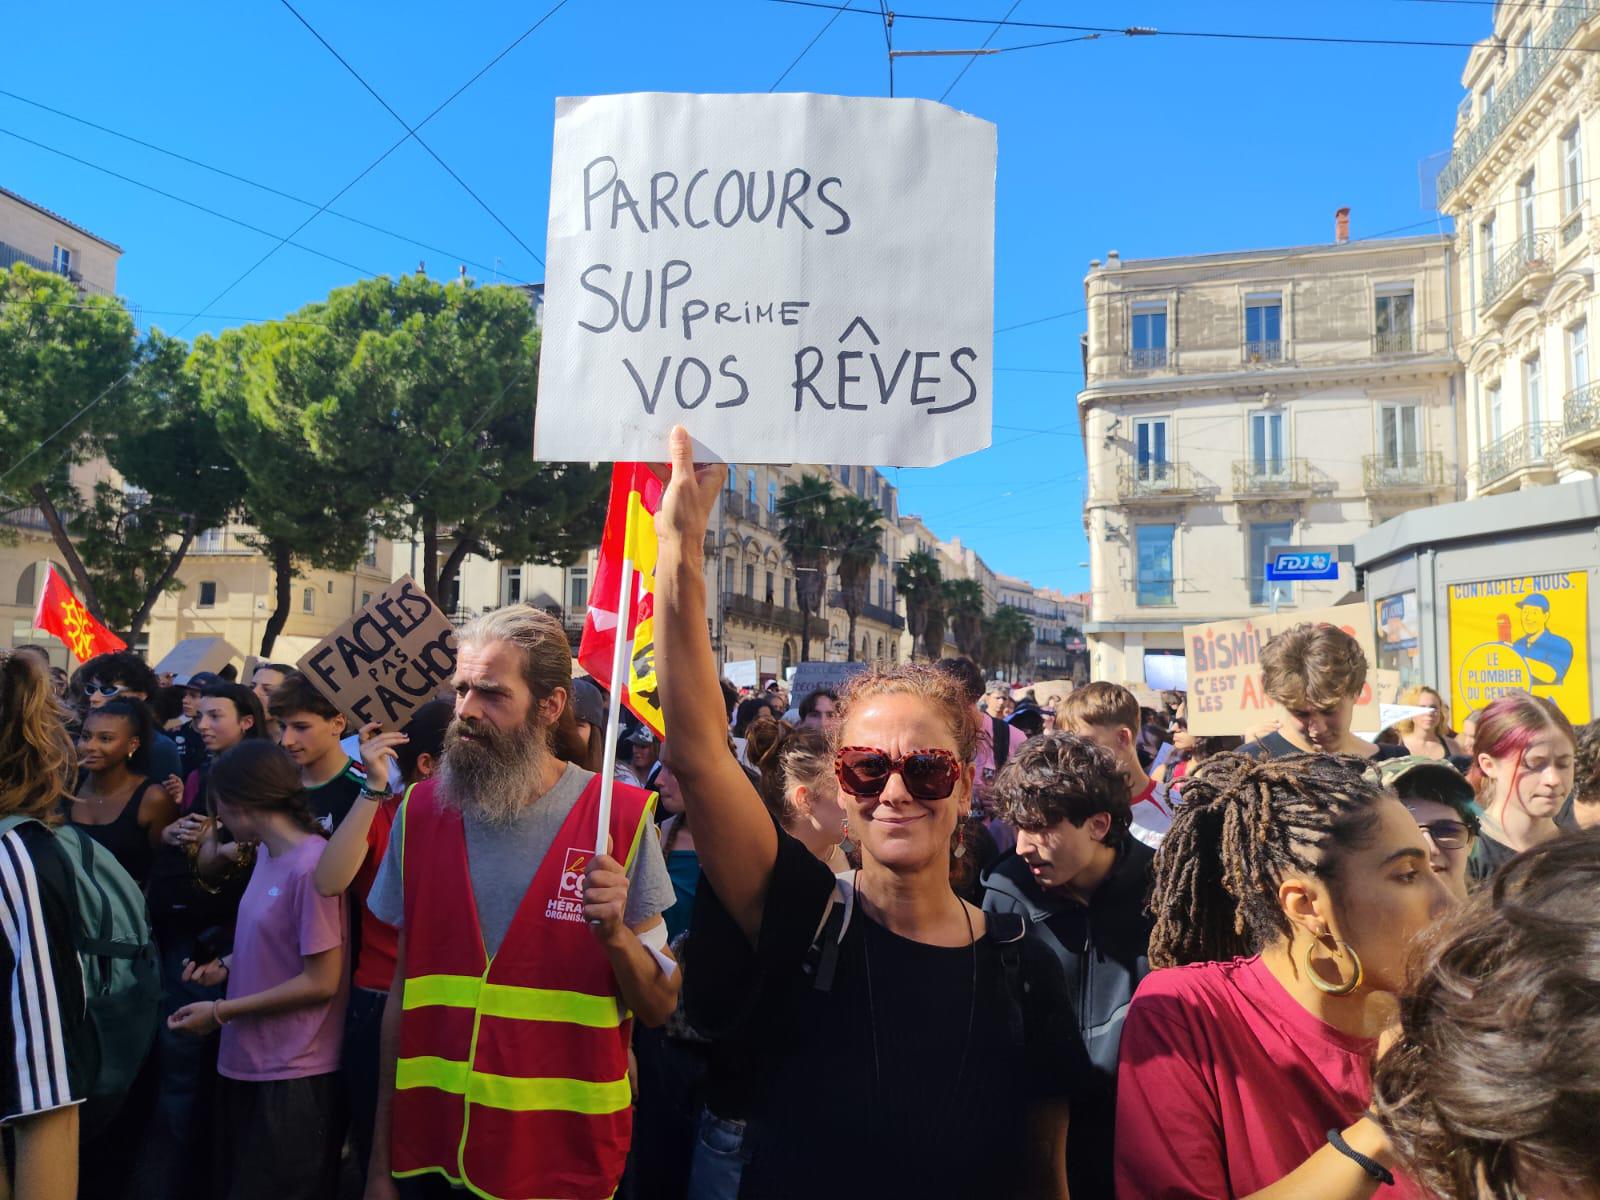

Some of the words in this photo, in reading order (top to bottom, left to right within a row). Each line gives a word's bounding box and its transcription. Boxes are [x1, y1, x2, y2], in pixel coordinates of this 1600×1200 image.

[583, 155, 851, 235] PARCOURS
[622, 354, 750, 415] VOS
[791, 316, 978, 415] RÊVES
[1278, 556, 1310, 570] FDJ
[368, 648, 408, 681] PAS
[1488, 652, 1499, 666] LE
[1468, 669, 1522, 683] PLOMBIER
[1194, 675, 1237, 695] C'EST
[1468, 687, 1479, 699] DU
[1197, 696, 1223, 713] LES
[547, 898, 585, 913] HÉRA
